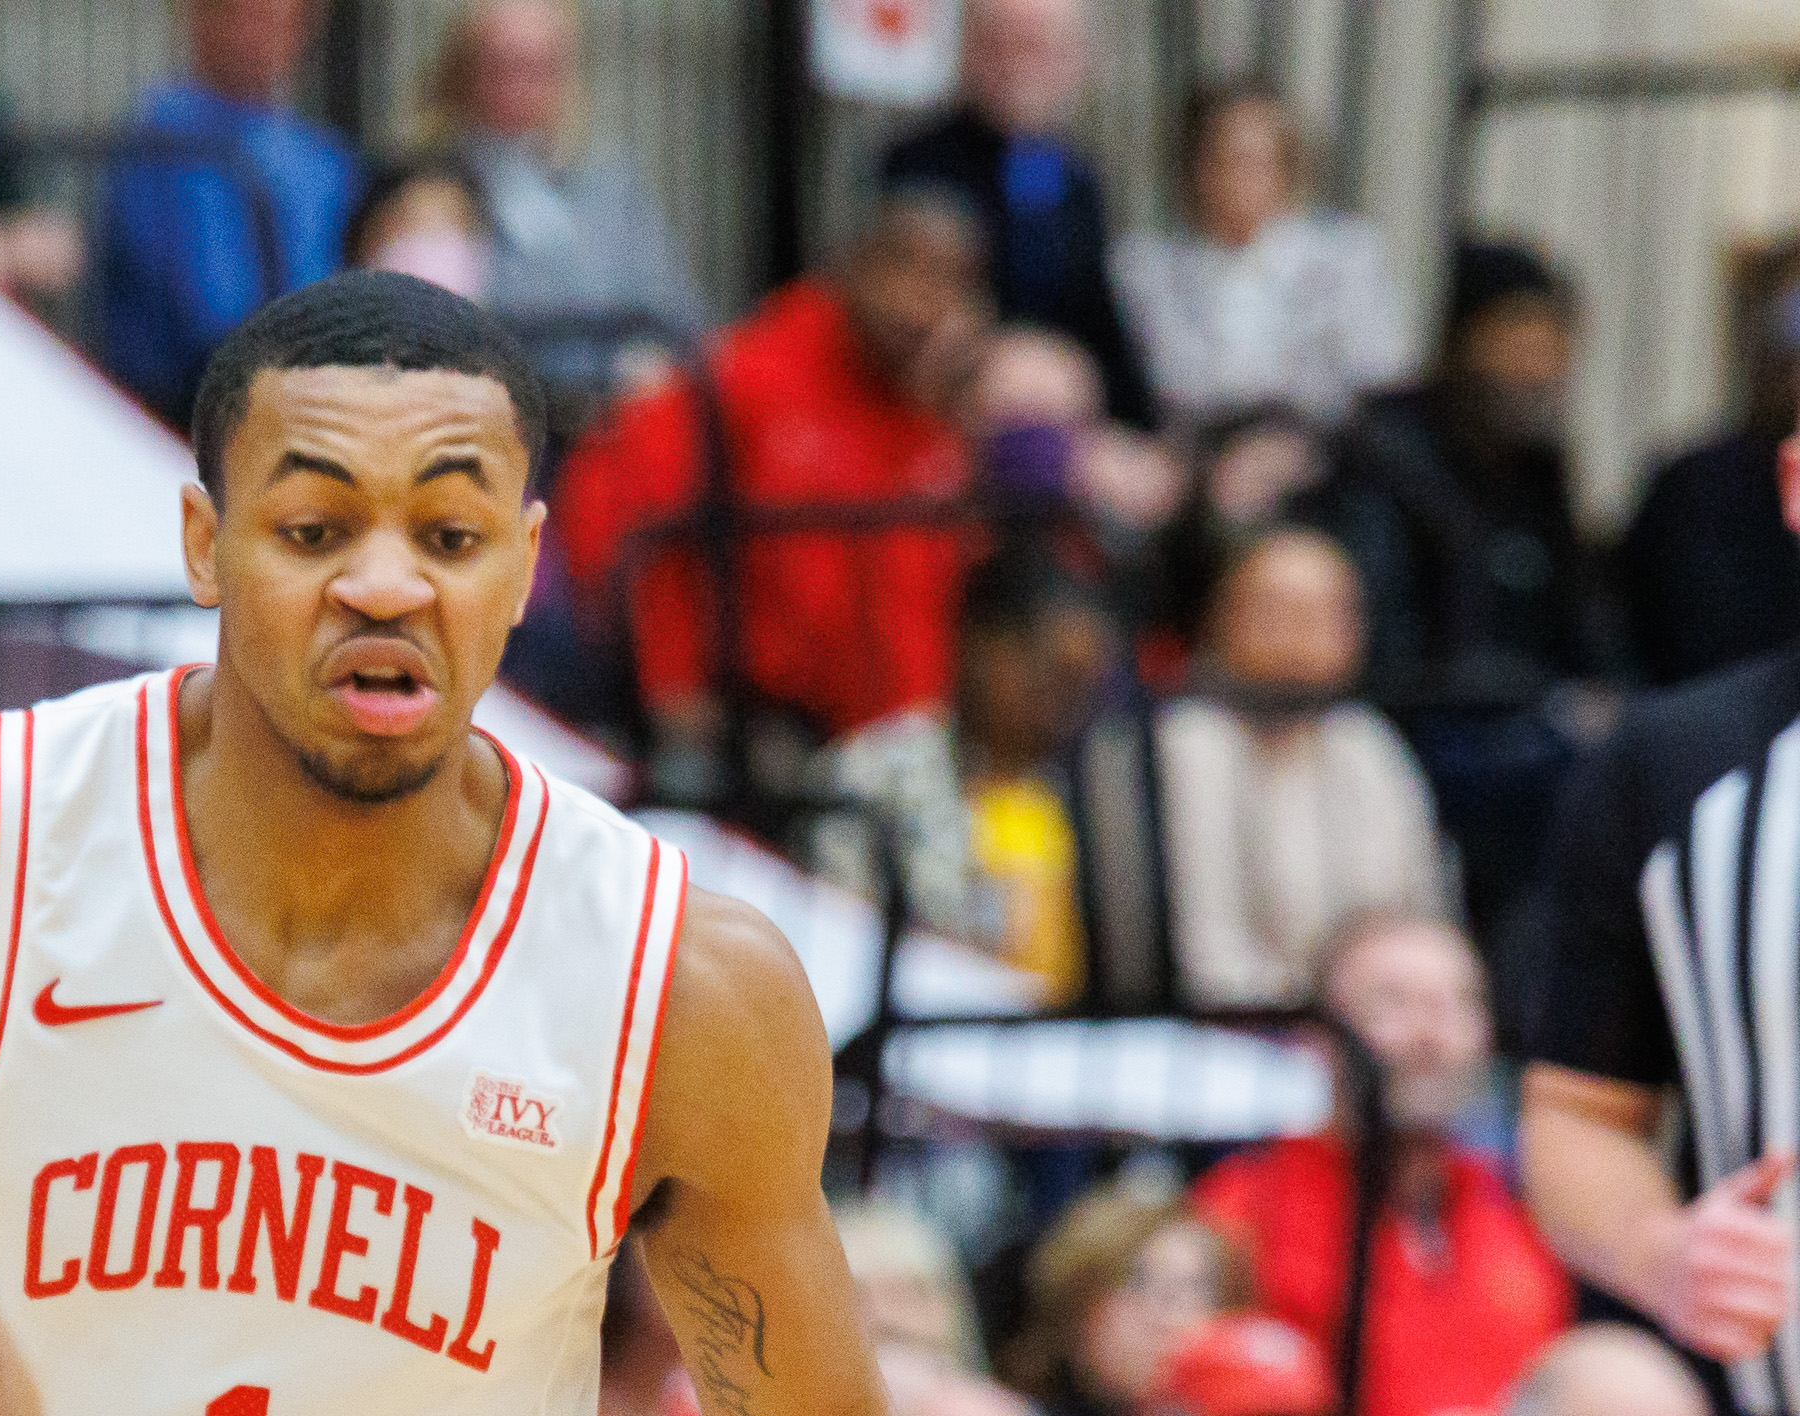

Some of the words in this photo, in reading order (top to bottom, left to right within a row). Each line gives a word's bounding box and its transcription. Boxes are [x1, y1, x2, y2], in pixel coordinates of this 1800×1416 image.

[491, 1093, 556, 1131] IVY
[487, 1121, 550, 1146] LEAGUE
[23, 1142, 501, 1374] CORNELL
